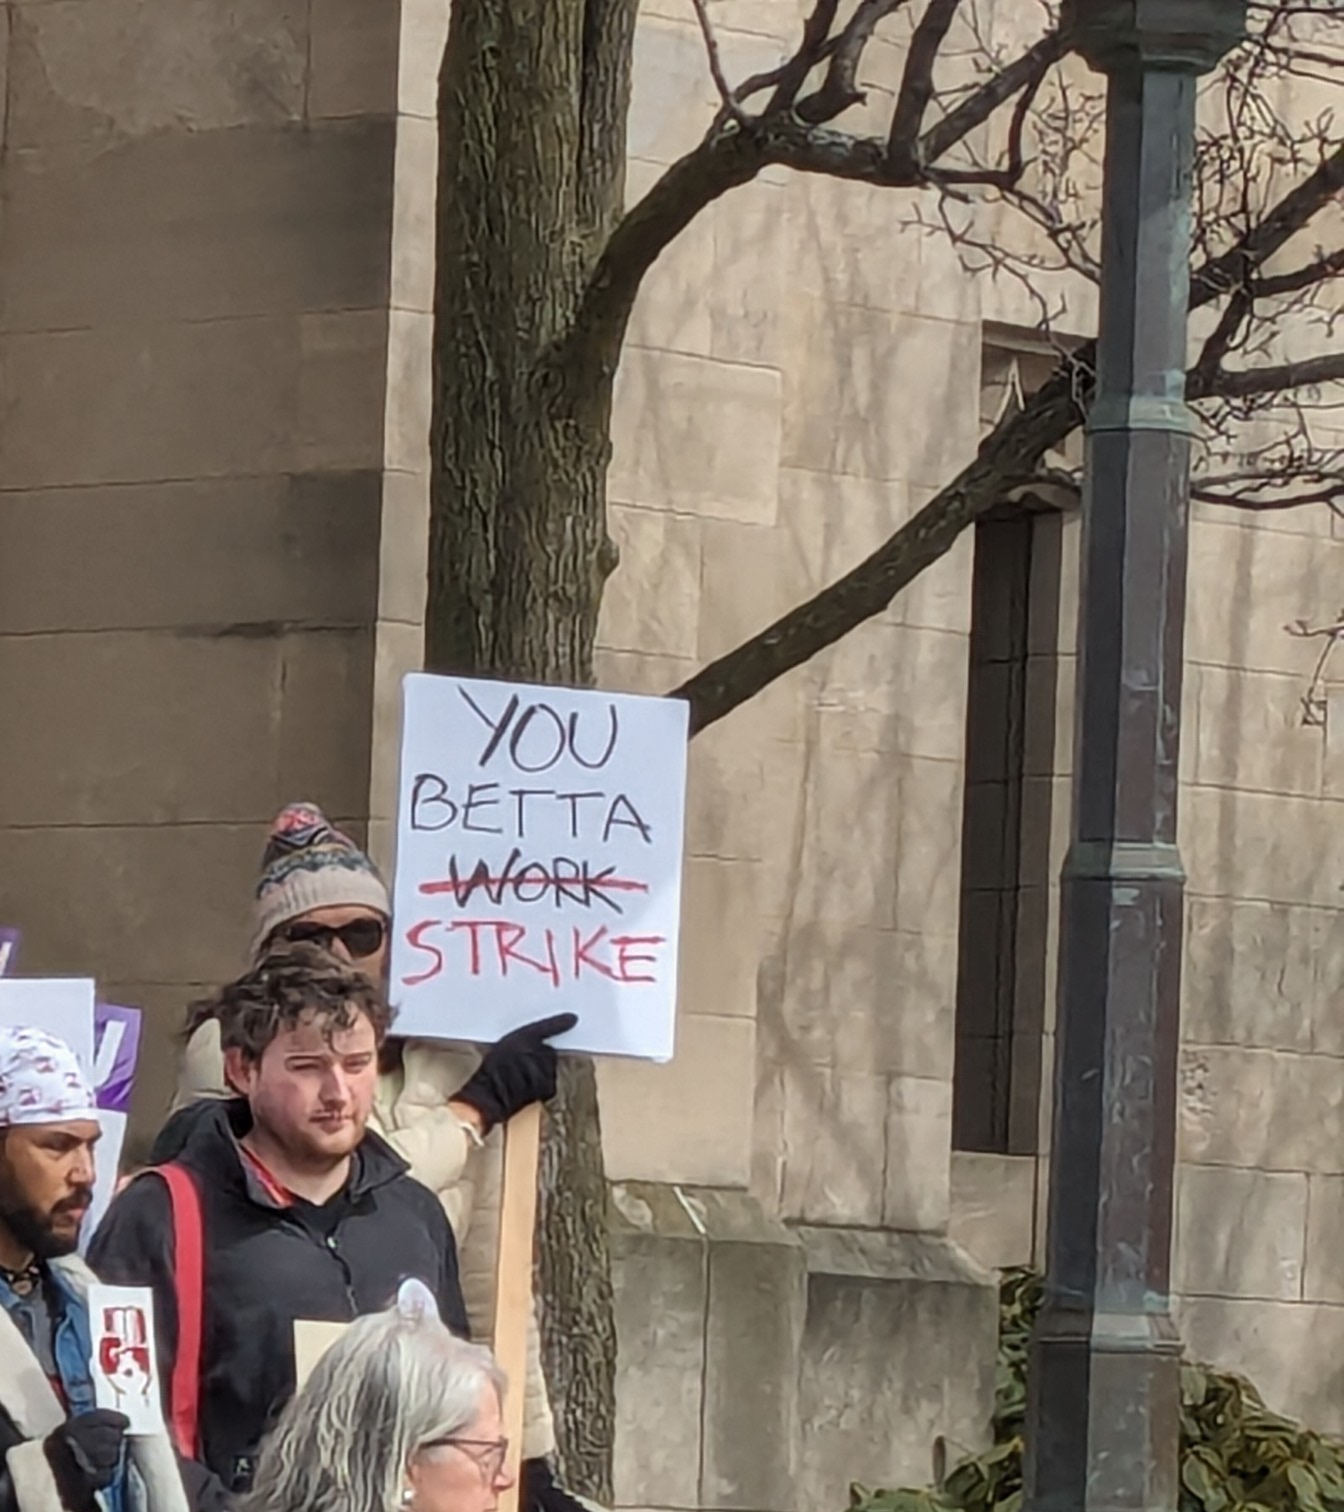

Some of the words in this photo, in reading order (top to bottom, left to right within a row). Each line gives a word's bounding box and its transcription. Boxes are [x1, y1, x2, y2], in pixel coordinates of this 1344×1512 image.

[457, 684, 619, 773] YOU
[411, 773, 653, 844] BETTA
[448, 847, 624, 914] WORK
[402, 919, 667, 988] STRIKE
